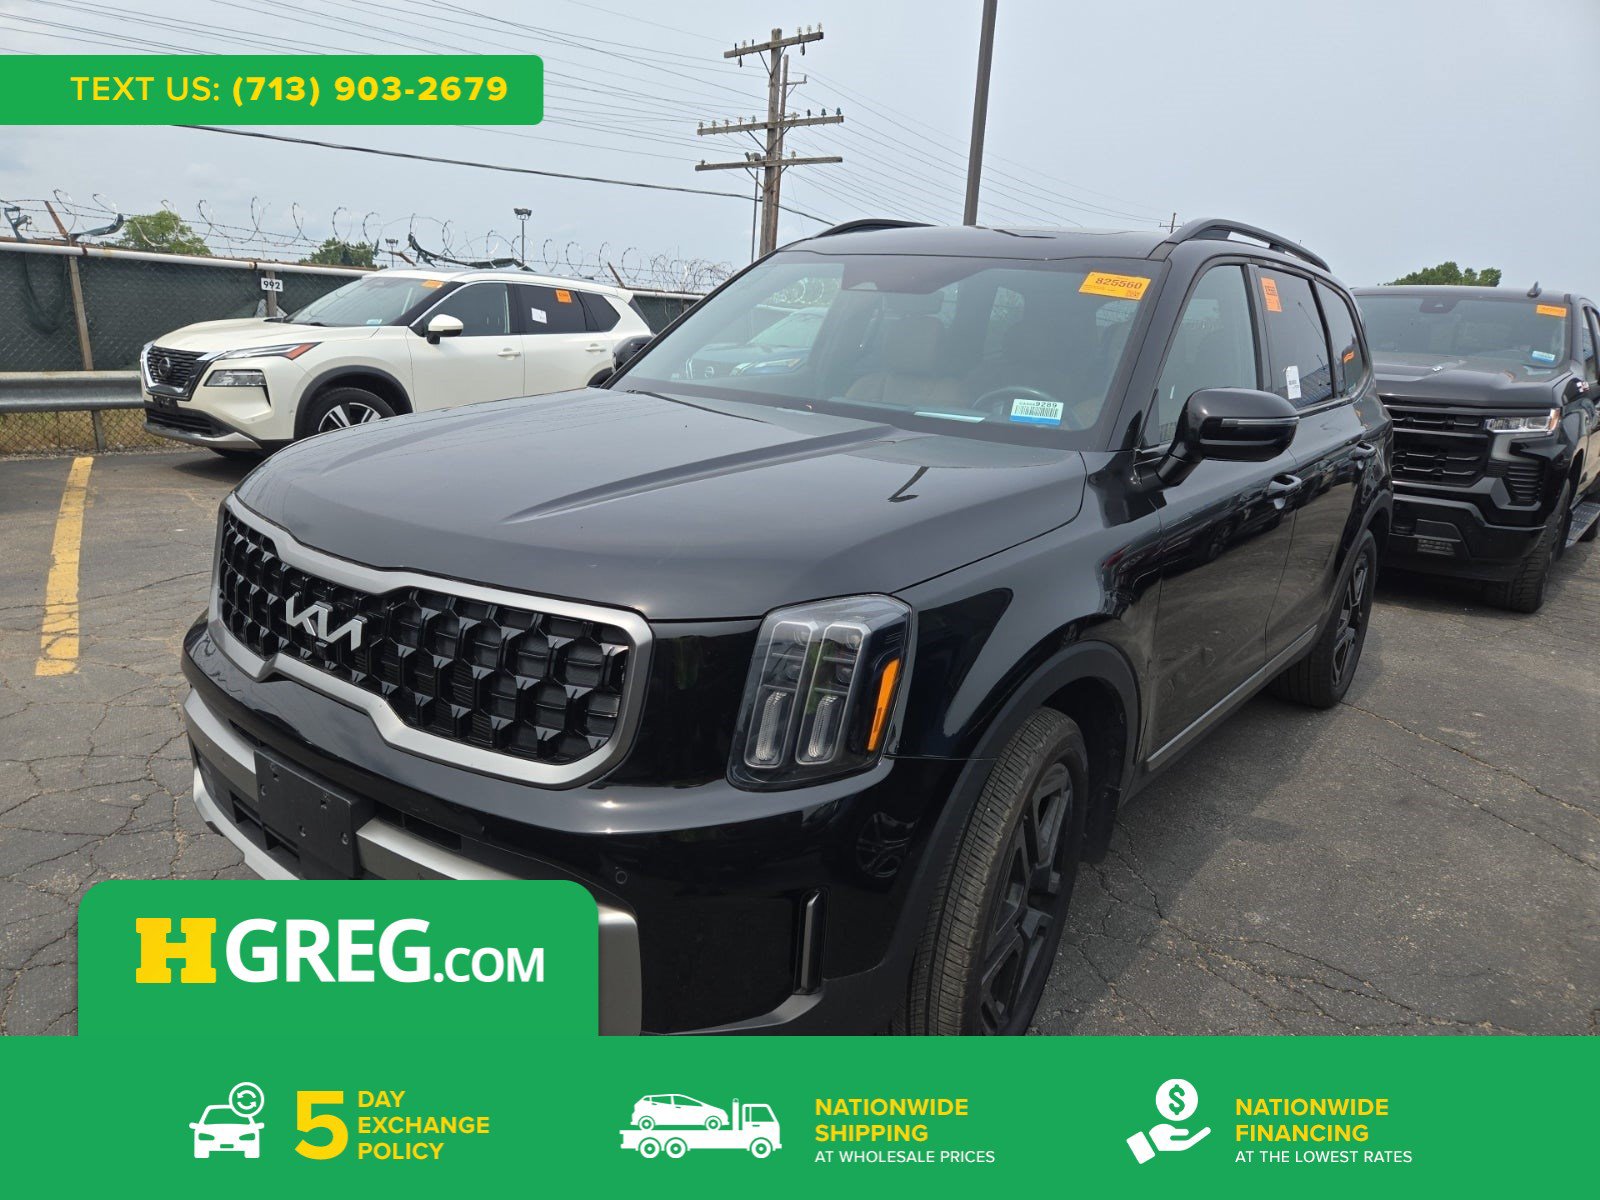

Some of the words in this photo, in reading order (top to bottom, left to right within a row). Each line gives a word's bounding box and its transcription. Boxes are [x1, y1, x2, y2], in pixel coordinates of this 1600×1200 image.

[263, 281, 281, 289] 992
[1095, 278, 1142, 289] 825560
[286, 594, 364, 652] KIA
